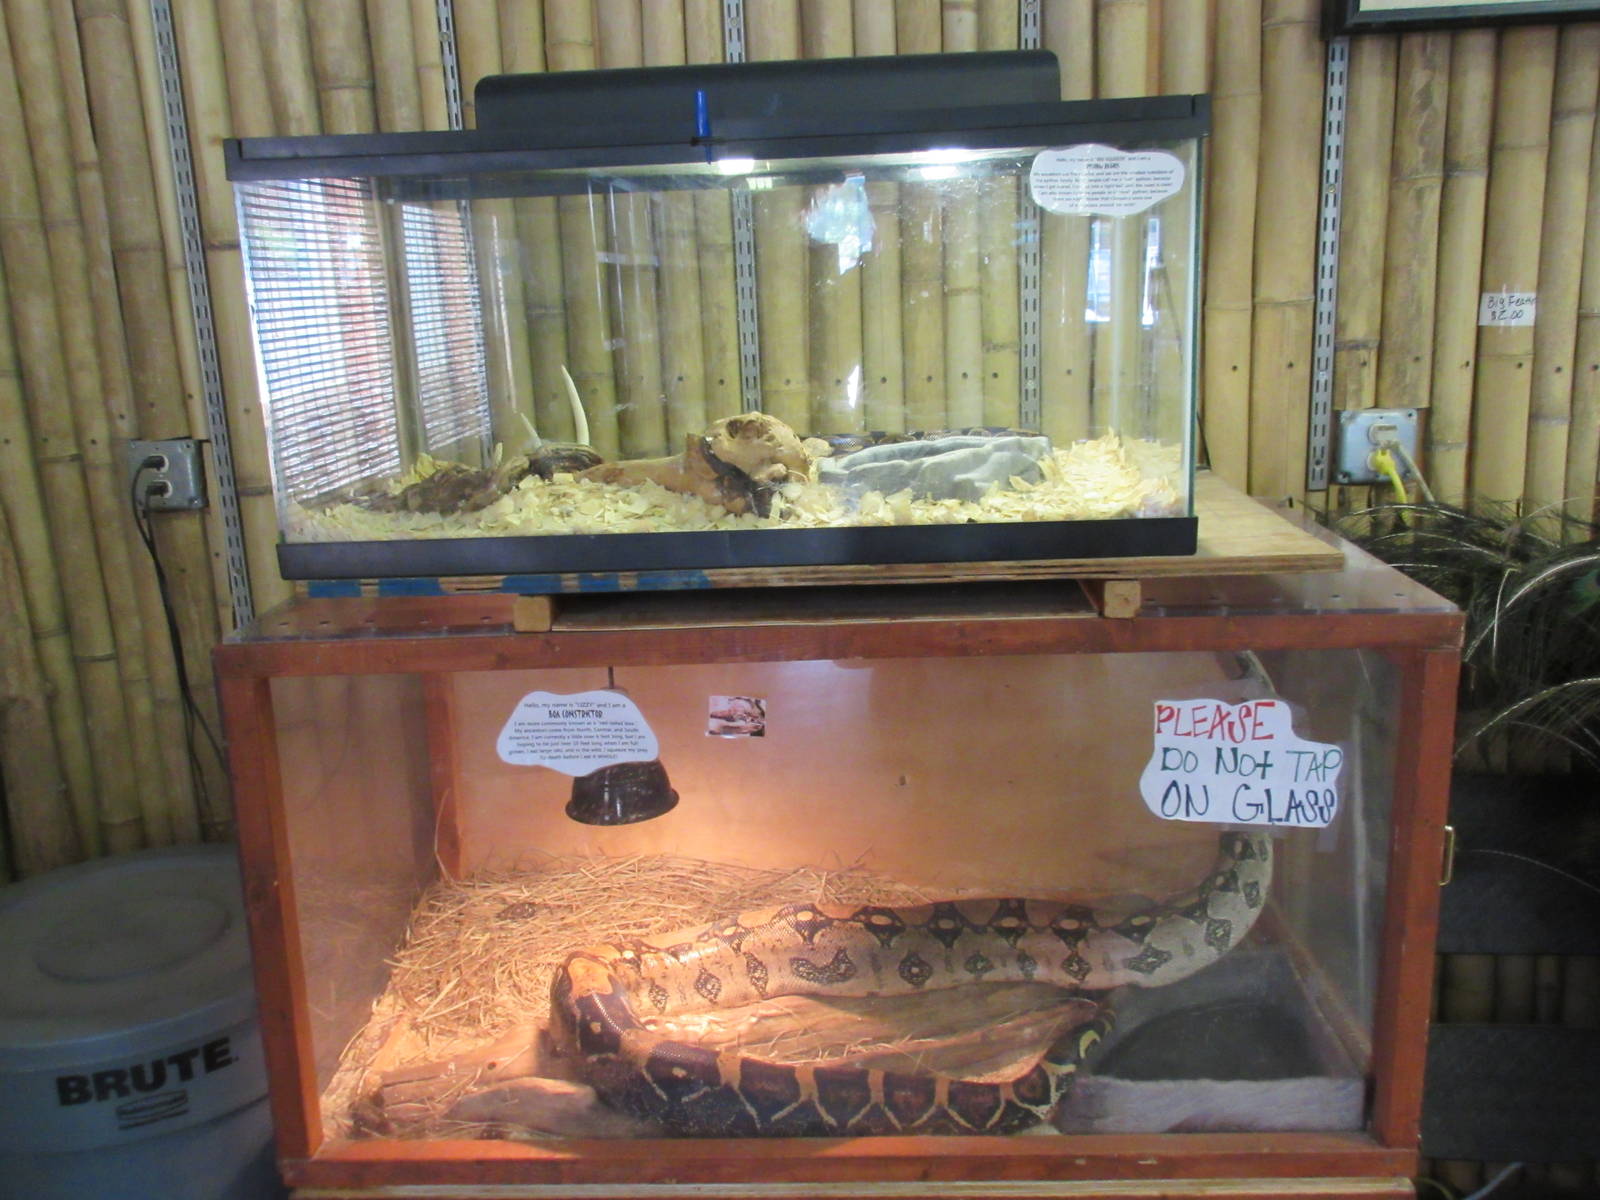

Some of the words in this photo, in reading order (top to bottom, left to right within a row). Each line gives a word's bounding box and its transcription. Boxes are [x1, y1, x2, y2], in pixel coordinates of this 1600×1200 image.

[549, 710, 560, 718] BOA
[1155, 701, 1276, 744] PLEASE
[1160, 747, 1199, 773] DO
[1286, 748, 1343, 783] TAP
[1161, 779, 1209, 818] ON
[1232, 783, 1335, 825] GLASS
[56, 1036, 232, 1107] BRUTE
